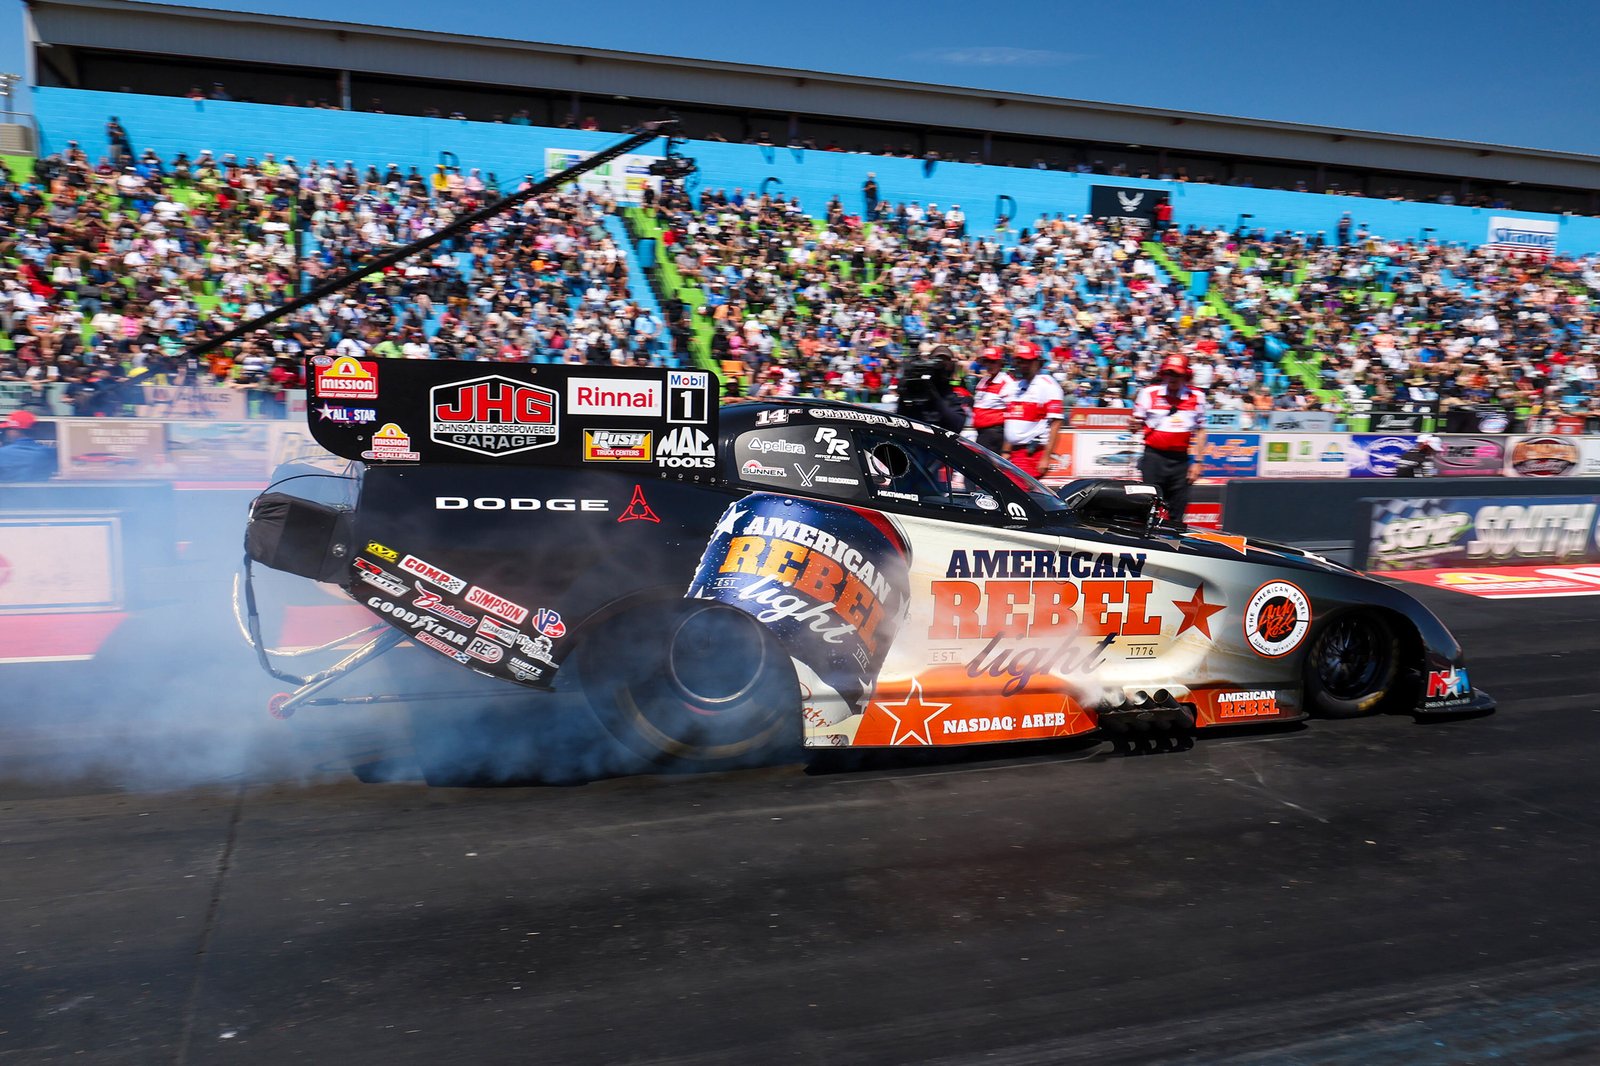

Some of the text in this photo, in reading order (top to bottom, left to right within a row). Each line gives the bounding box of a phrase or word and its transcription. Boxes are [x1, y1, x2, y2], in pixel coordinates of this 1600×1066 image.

[670, 374, 706, 388] Mobil
[435, 382, 553, 425] JHG
[577, 386, 653, 408] Rinnai
[680, 390, 693, 418] 1
[333, 409, 376, 421] ALL STAR
[755, 408, 788, 427] 14
[433, 423, 556, 435] JOHNSON'S HORSEPOWERED
[452, 434, 537, 450] GARAGE
[656, 426, 716, 457] MAC
[616, 449, 640, 457] CENTERS
[656, 457, 716, 468] TOOLS
[742, 466, 785, 477] SUNNEN
[435, 496, 609, 511] DODGE
[404, 558, 450, 583] COMP
[742, 516, 891, 604] AMERICAN
[946, 550, 1147, 579] AMERICAN
[716, 578, 736, 588] EST
[470, 589, 525, 622] SIMPSON
[719, 535, 886, 656] REBEL
[1254, 586, 1289, 608] AMERICAN
[1293, 592, 1306, 616] REBEL
[738, 573, 858, 644] light
[928, 580, 1162, 640] REBEL
[538, 608, 560, 632] VP
[482, 622, 515, 641] CHAMPION
[932, 651, 956, 662] EST
[1129, 646, 1155, 657] 1776
[966, 630, 1117, 698] light
[1217, 690, 1276, 703] AMERICAN
[1220, 699, 1280, 719] REBEL
[943, 712, 1065, 734] NASDAQ: AREB
